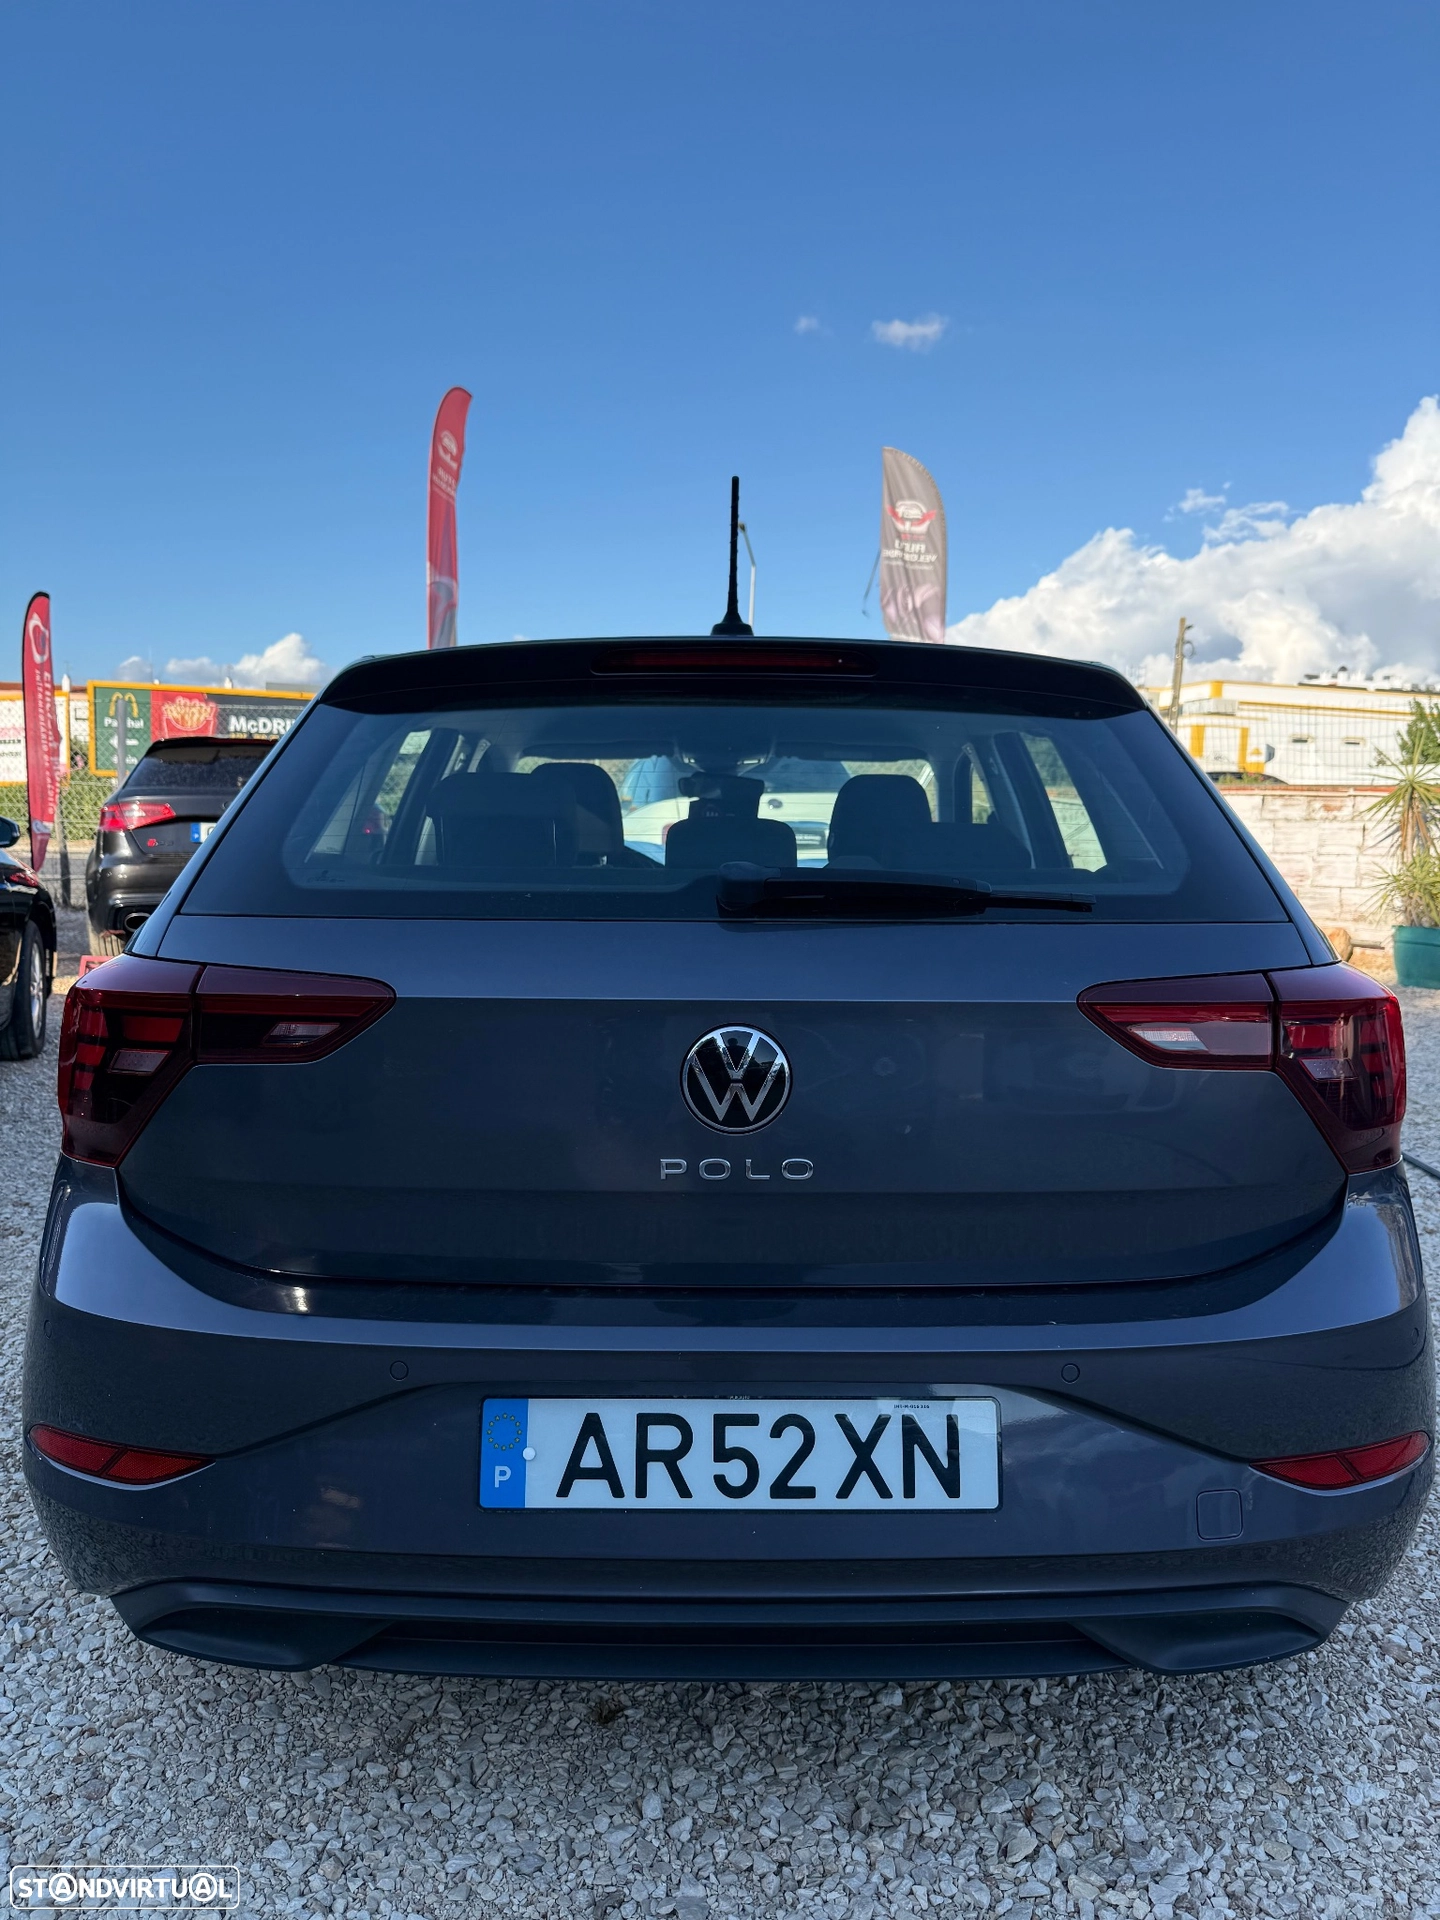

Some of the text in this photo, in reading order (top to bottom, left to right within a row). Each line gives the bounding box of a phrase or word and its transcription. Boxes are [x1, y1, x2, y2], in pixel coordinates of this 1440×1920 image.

[229, 714, 297, 735] McDRI
[660, 1158, 814, 1181] POLO
[494, 1465, 512, 1488] P
